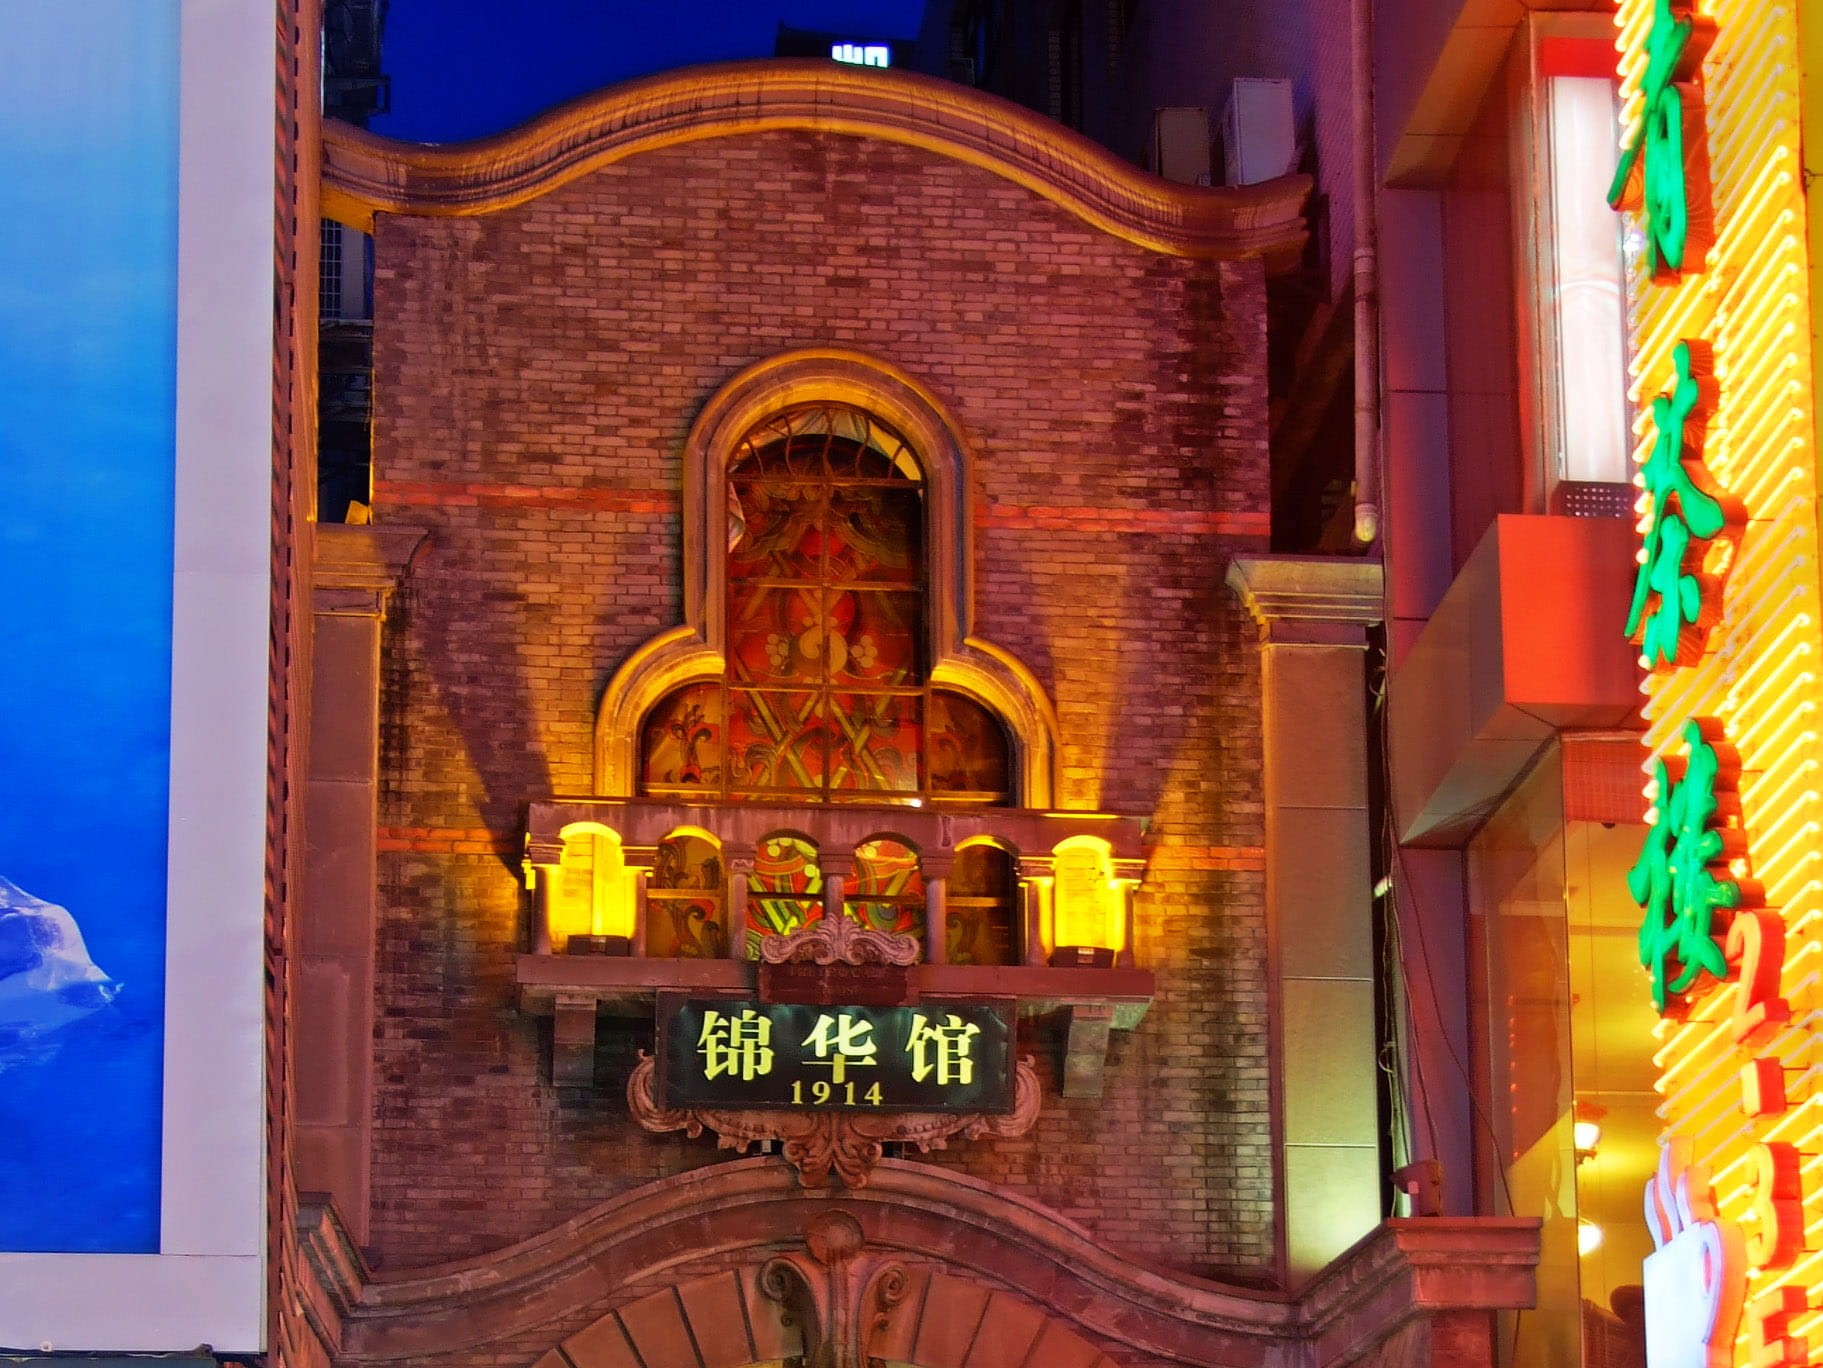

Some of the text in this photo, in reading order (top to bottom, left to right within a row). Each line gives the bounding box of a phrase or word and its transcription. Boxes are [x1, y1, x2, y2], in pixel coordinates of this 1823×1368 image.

[697, 1009, 981, 1085] 锦华馆
[791, 1080, 883, 1105] 1914
